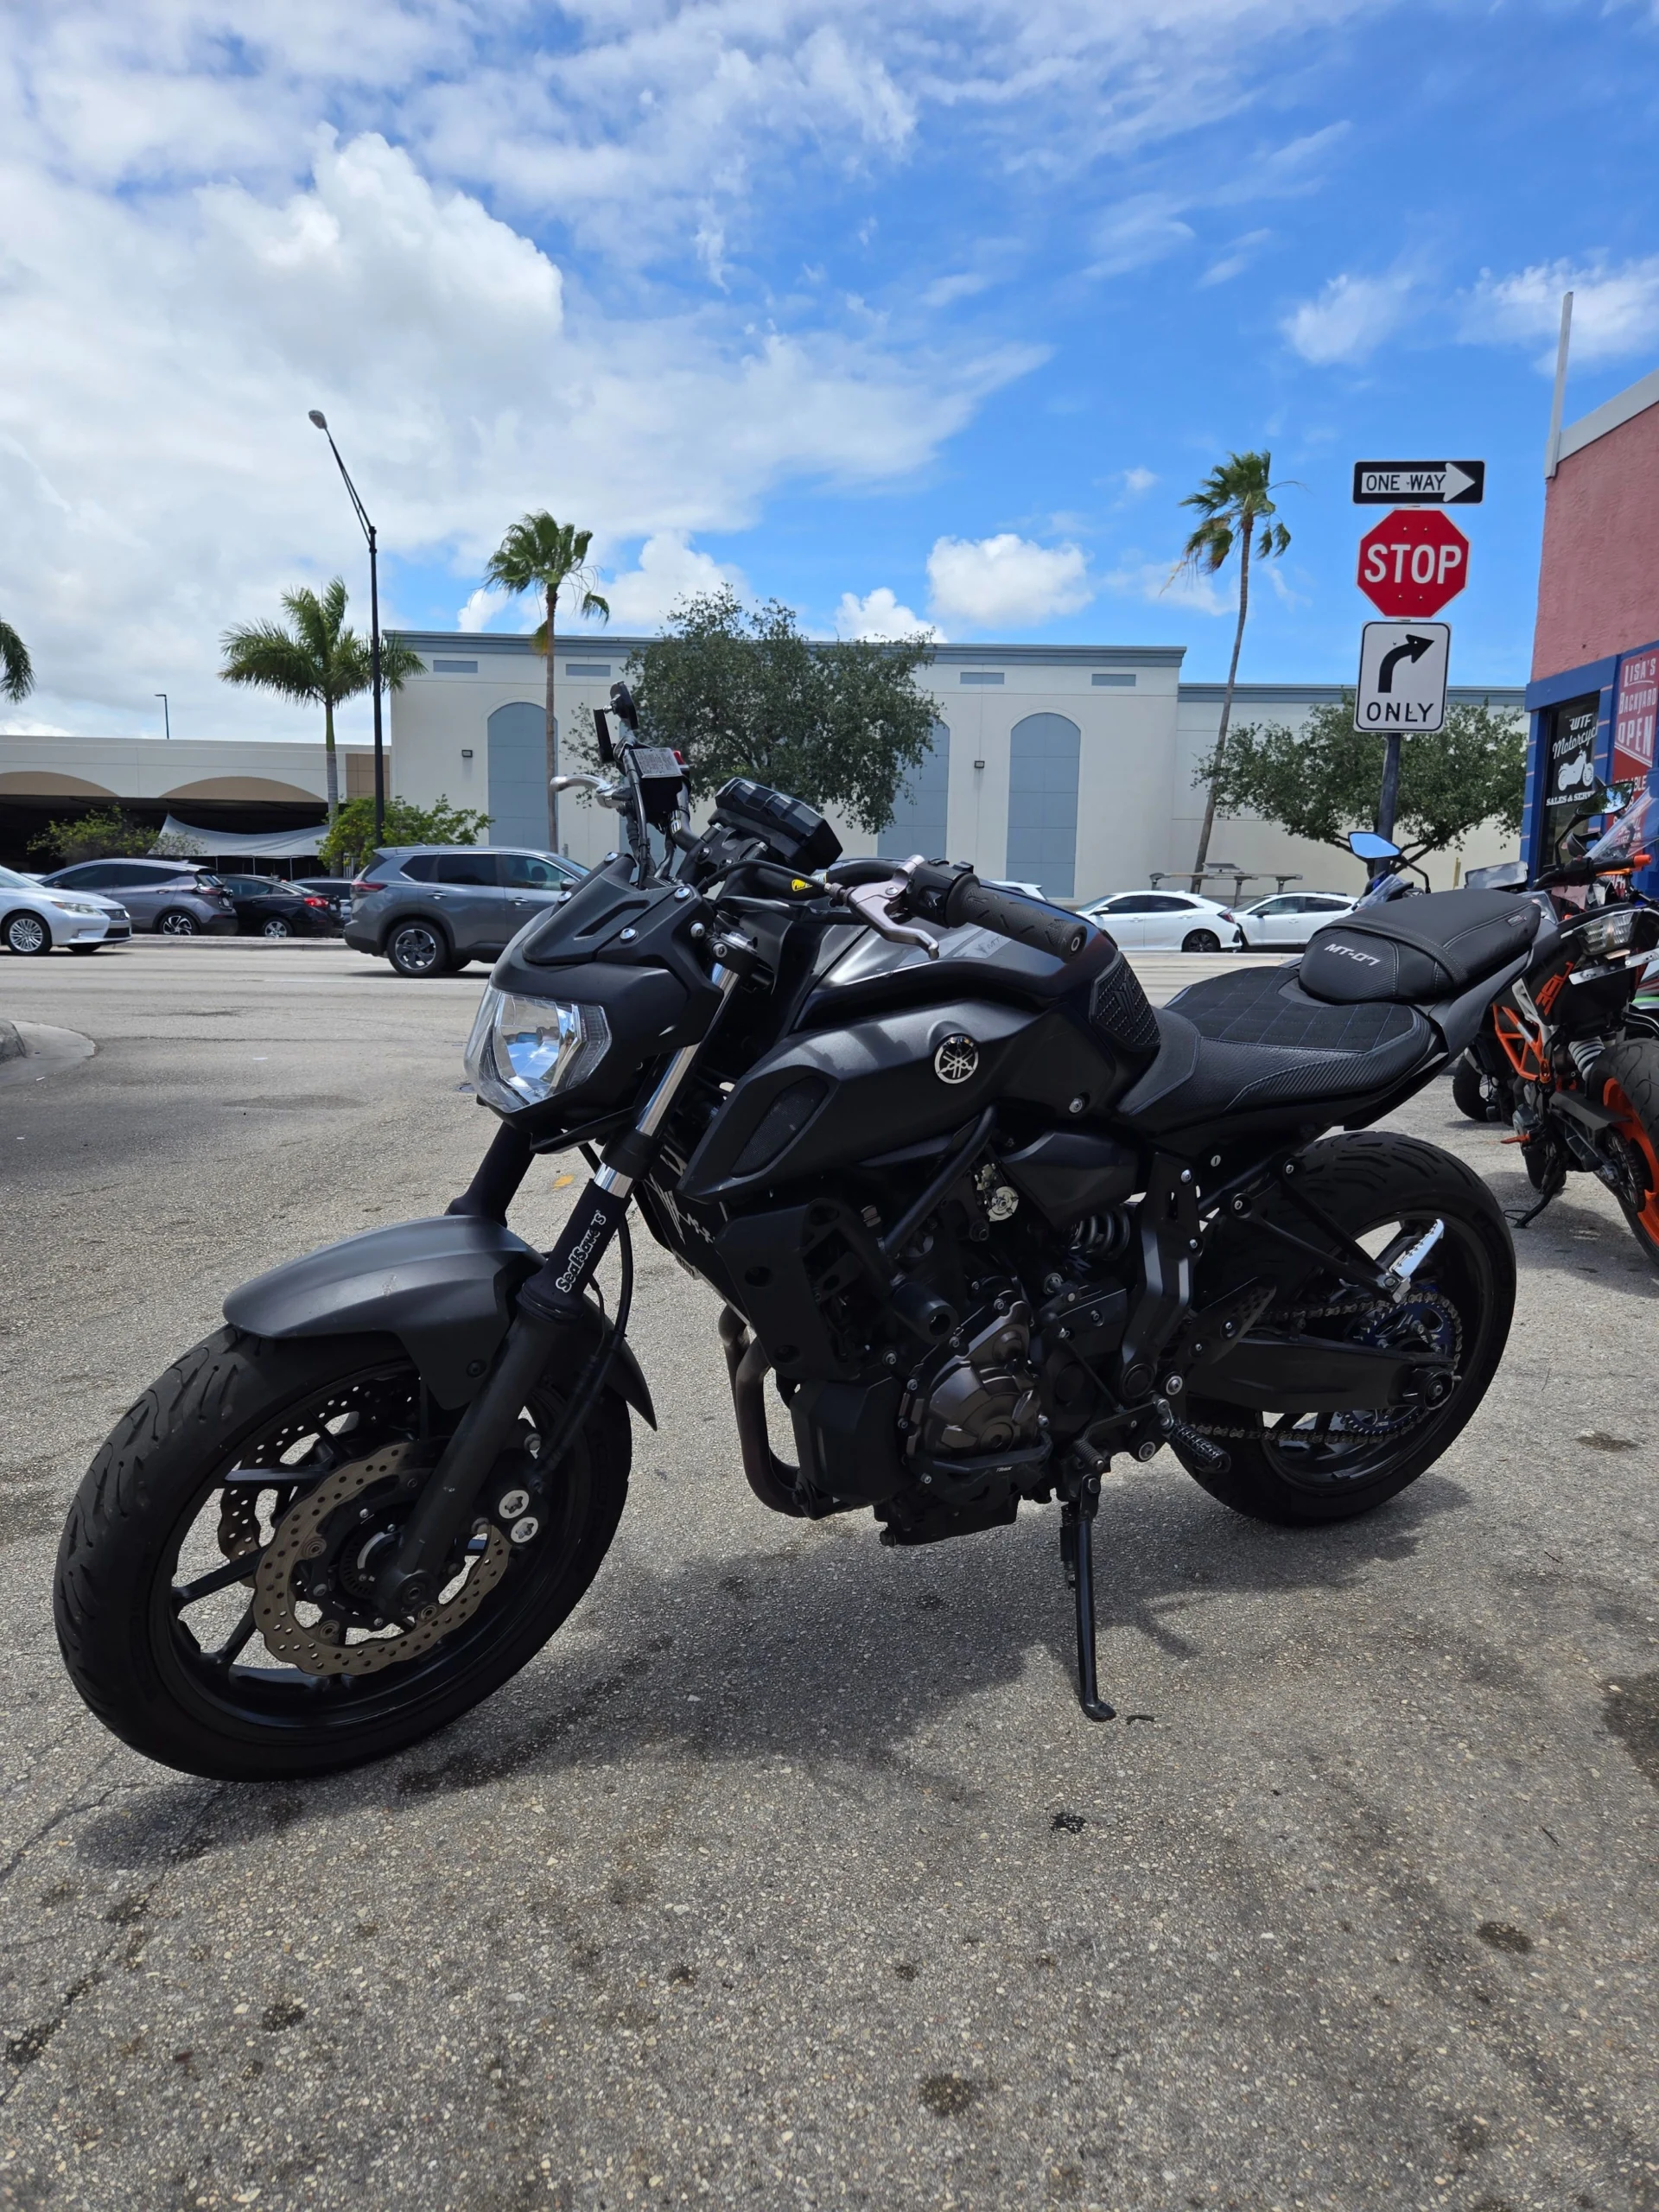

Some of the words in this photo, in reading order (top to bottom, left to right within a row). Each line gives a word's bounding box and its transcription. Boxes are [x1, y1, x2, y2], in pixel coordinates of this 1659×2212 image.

[1366, 474, 1400, 491] ONE
[1410, 474, 1446, 491] WAY
[1364, 543, 1462, 584] STOP
[1624, 658, 1656, 688] LISA'S
[1367, 702, 1434, 722] ONLY
[1618, 687, 1657, 715] BACKYARD
[1569, 713, 1593, 731] WTF
[1618, 715, 1653, 757] OPEN
[1553, 719, 1599, 760] Motorcycl
[1546, 794, 1567, 806] SALES
[1567, 794, 1573, 803] &
[1324, 944, 1381, 966] MT-07
[556, 1210, 607, 1293] SealSaves
